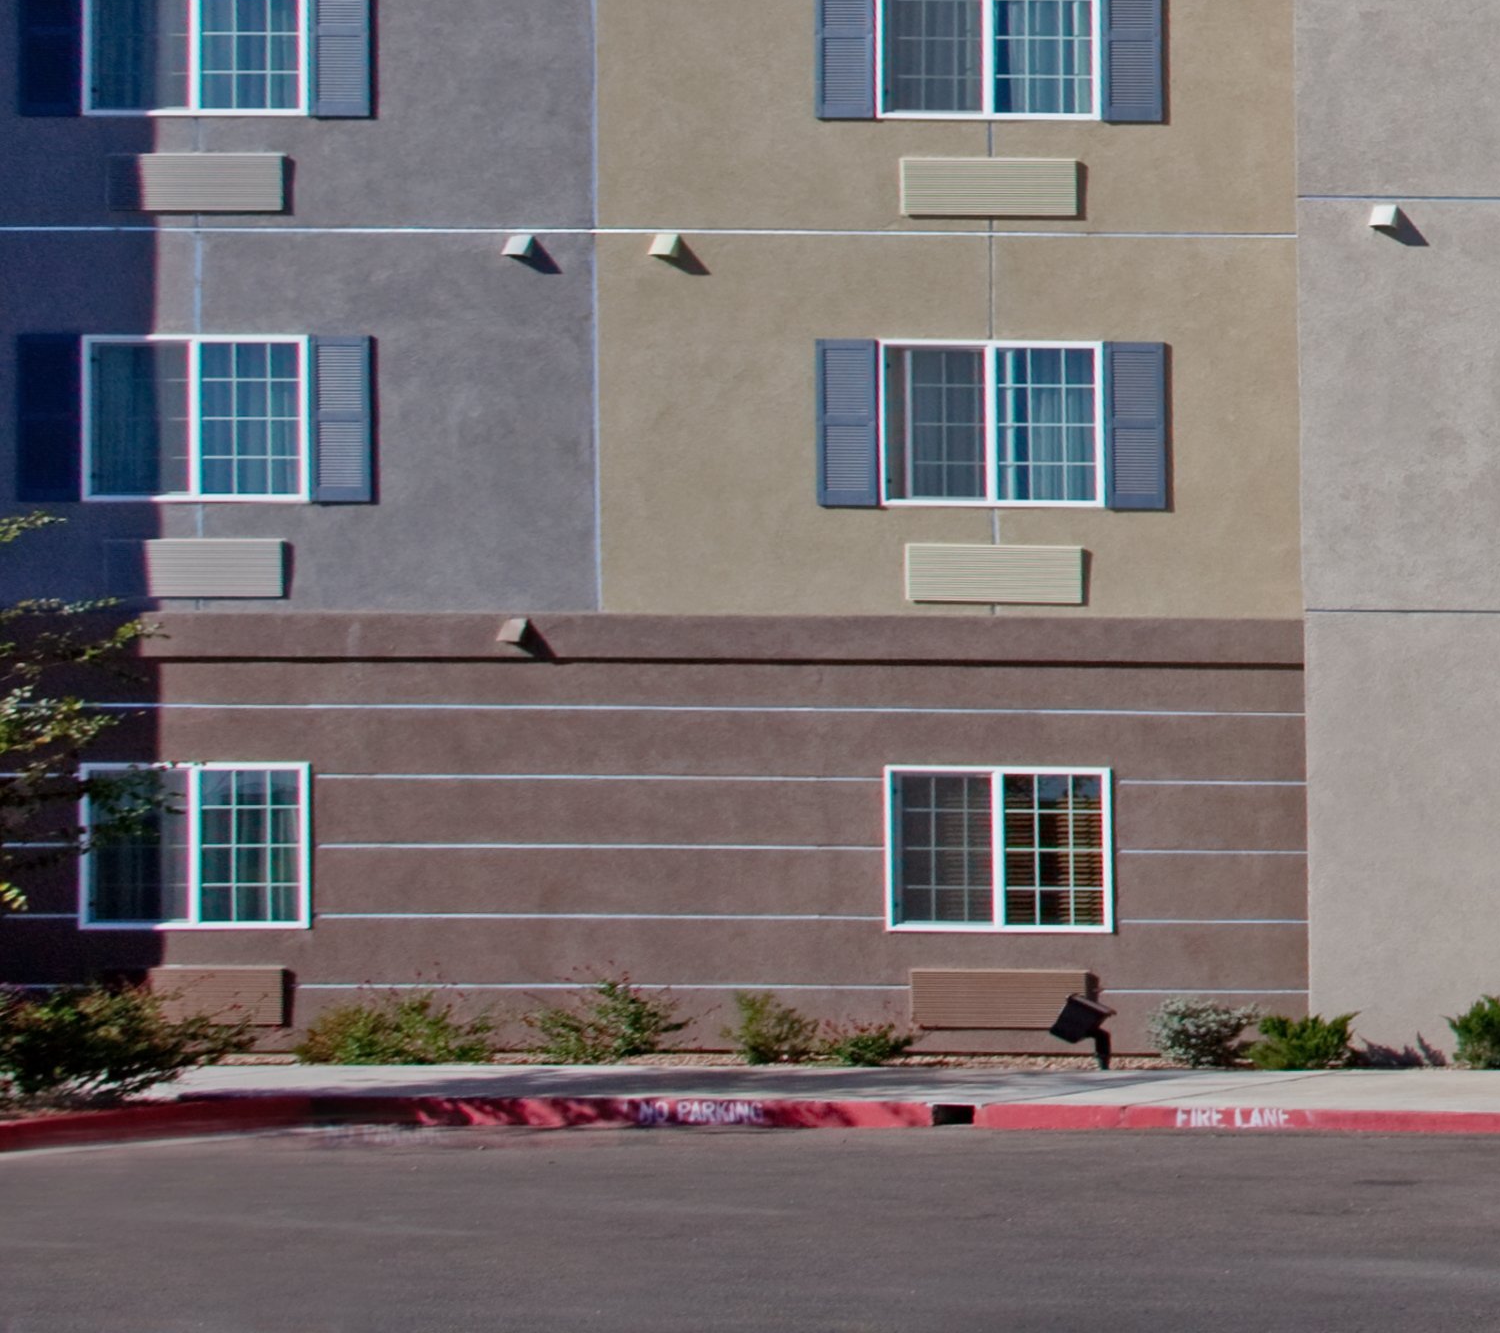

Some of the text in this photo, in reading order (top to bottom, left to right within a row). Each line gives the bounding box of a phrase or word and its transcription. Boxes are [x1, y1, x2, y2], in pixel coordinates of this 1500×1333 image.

[639, 1100, 764, 1123] NO PARKING
[1176, 1107, 1295, 1128] FIRE LANE
